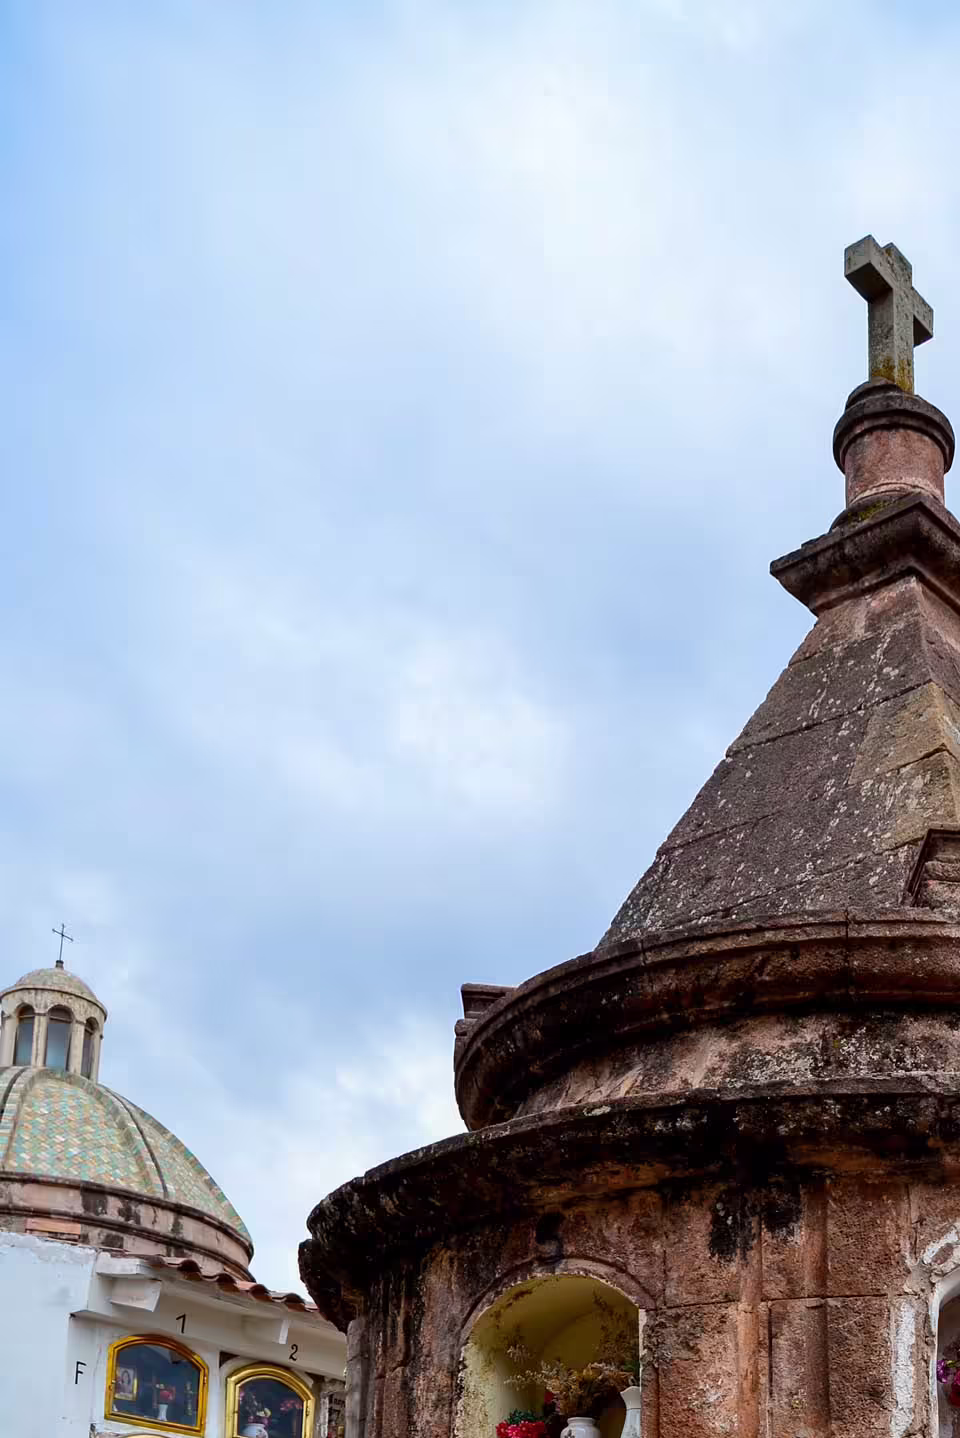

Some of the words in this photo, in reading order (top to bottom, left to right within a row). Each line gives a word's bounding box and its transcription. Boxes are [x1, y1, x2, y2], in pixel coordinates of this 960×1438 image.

[176, 1314, 187, 1333] 1
[289, 1344, 299, 1361] 2
[75, 1361, 87, 1385] F
